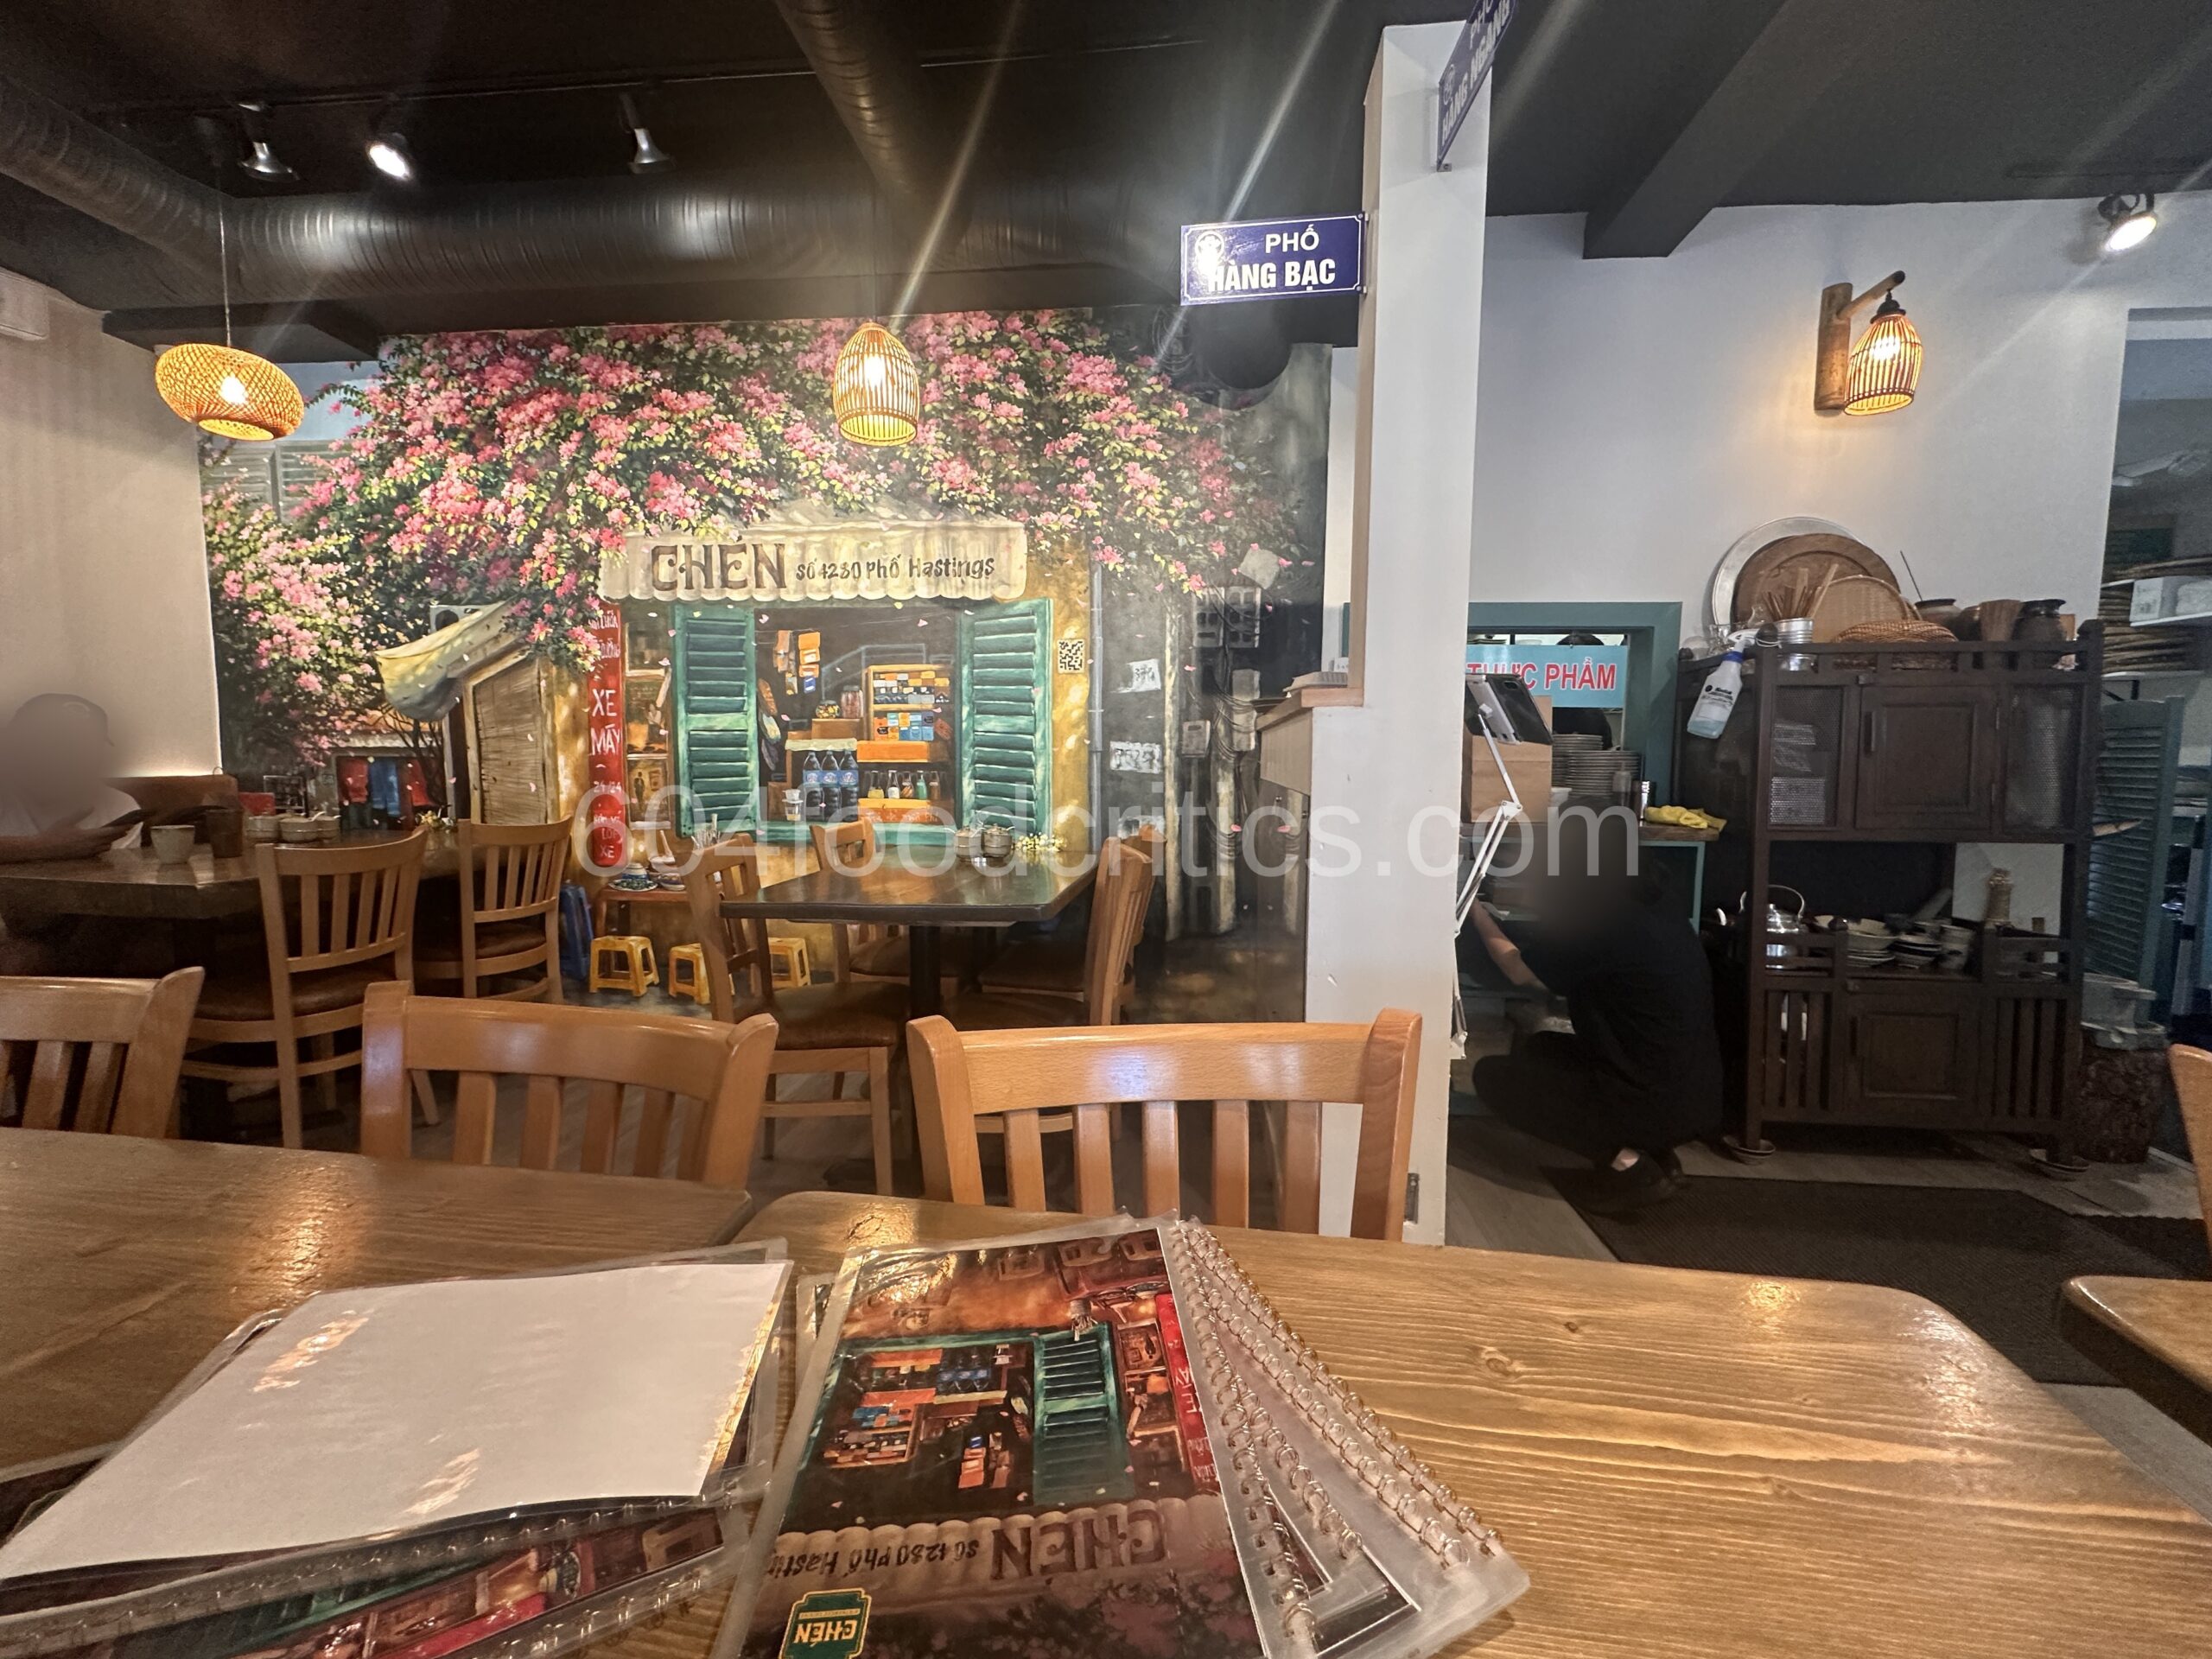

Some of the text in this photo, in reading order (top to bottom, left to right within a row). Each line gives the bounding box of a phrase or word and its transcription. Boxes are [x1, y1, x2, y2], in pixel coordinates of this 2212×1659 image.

[1265, 224, 1319, 254] PHỐ
[1284, 258, 1336, 291] BẠC
[908, 555, 995, 580] Hastings
[1544, 657, 1616, 690] PHẨM
[592, 689, 618, 718] XE
[990, 1510, 1166, 1586] CHÉN
[793, 1619, 858, 1648] CHÉN
